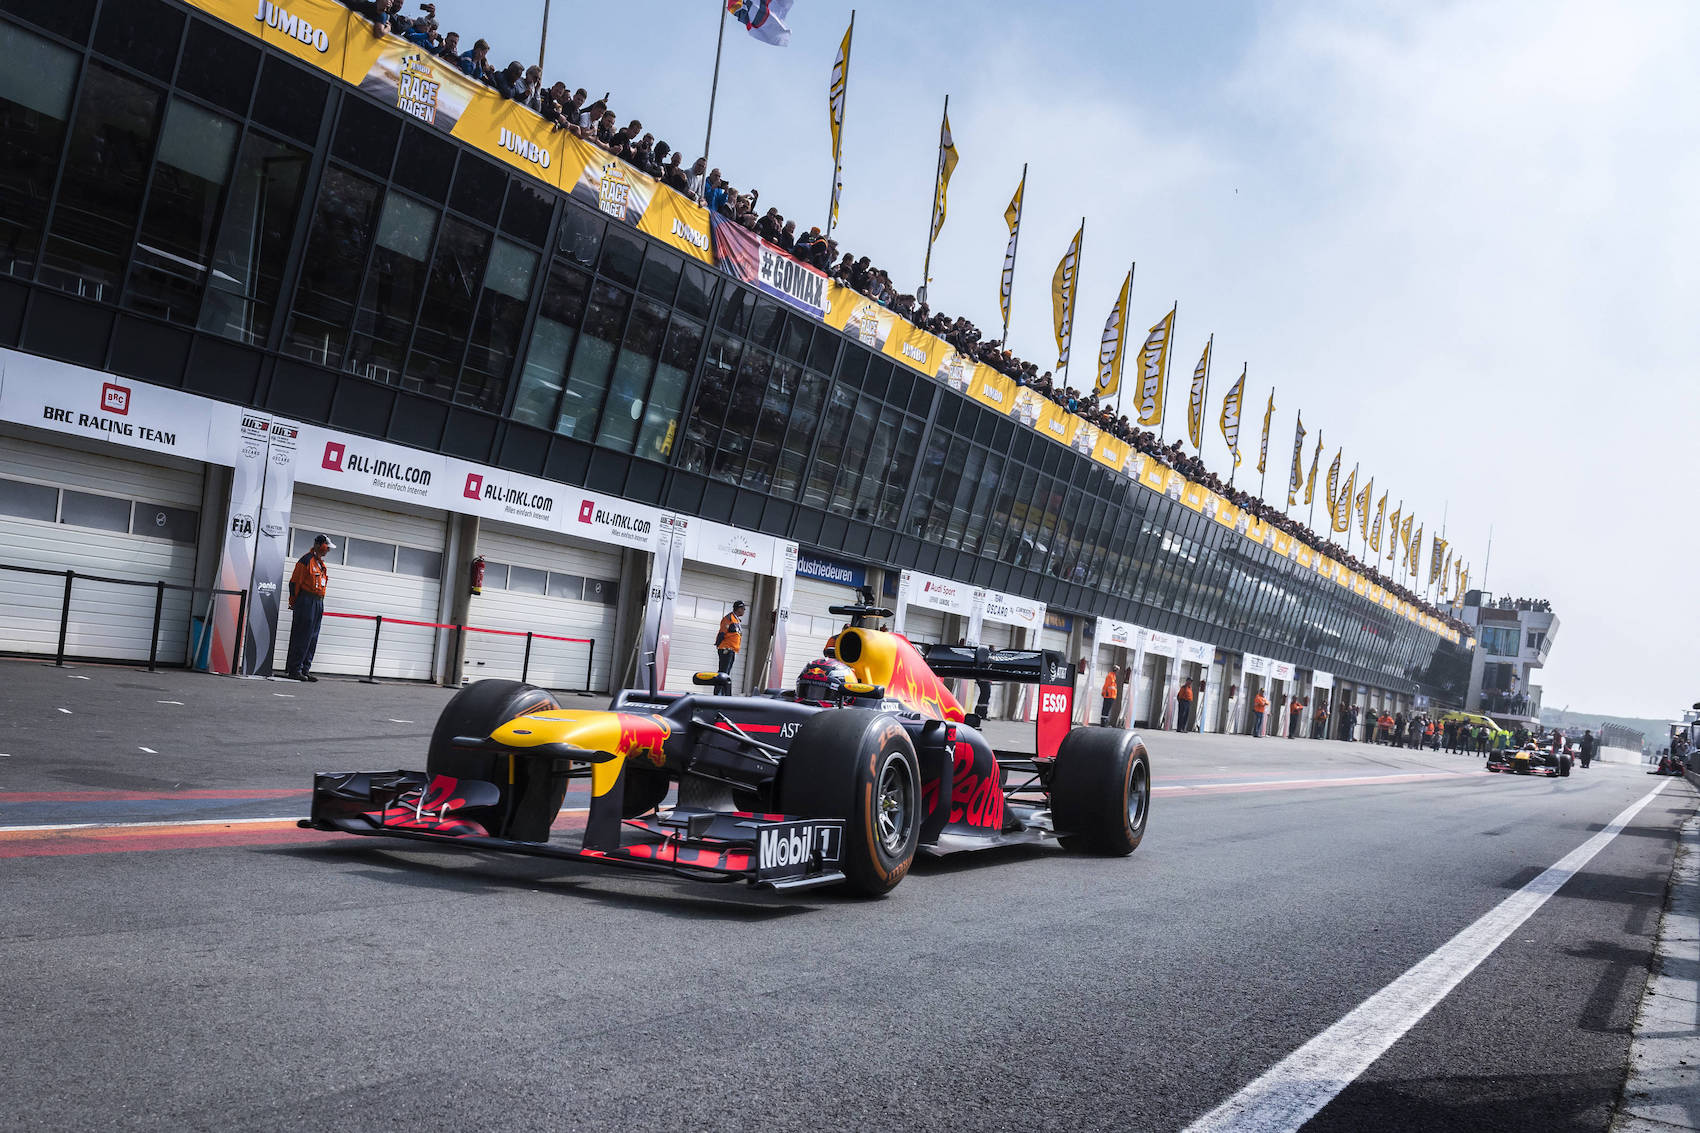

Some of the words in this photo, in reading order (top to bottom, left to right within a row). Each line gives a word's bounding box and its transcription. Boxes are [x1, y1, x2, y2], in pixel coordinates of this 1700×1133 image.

[254, 0, 329, 53] JUMBO
[400, 73, 439, 105] RACE
[497, 127, 551, 168] JUMBO
[600, 178, 628, 203] RACE
[670, 217, 710, 251] JUMBO
[761, 251, 826, 308] #GOMAX
[902, 342, 927, 364] JUMBO
[1140, 320, 1167, 420] JUMBO
[43, 406, 74, 424] BRC
[78, 413, 133, 437] RACING
[138, 426, 176, 446] TEAM
[347, 454, 432, 486] ALL-INKL.COM
[485, 484, 553, 512] ALL-INKL.COM
[595, 510, 651, 534] ALL-INKL.COM
[986, 604, 1009, 616] OSCARO
[1043, 693, 1067, 713] ESSO
[780, 722, 802, 738] AST
[760, 826, 812, 869] Mobil
[821, 829, 830, 857] 1
